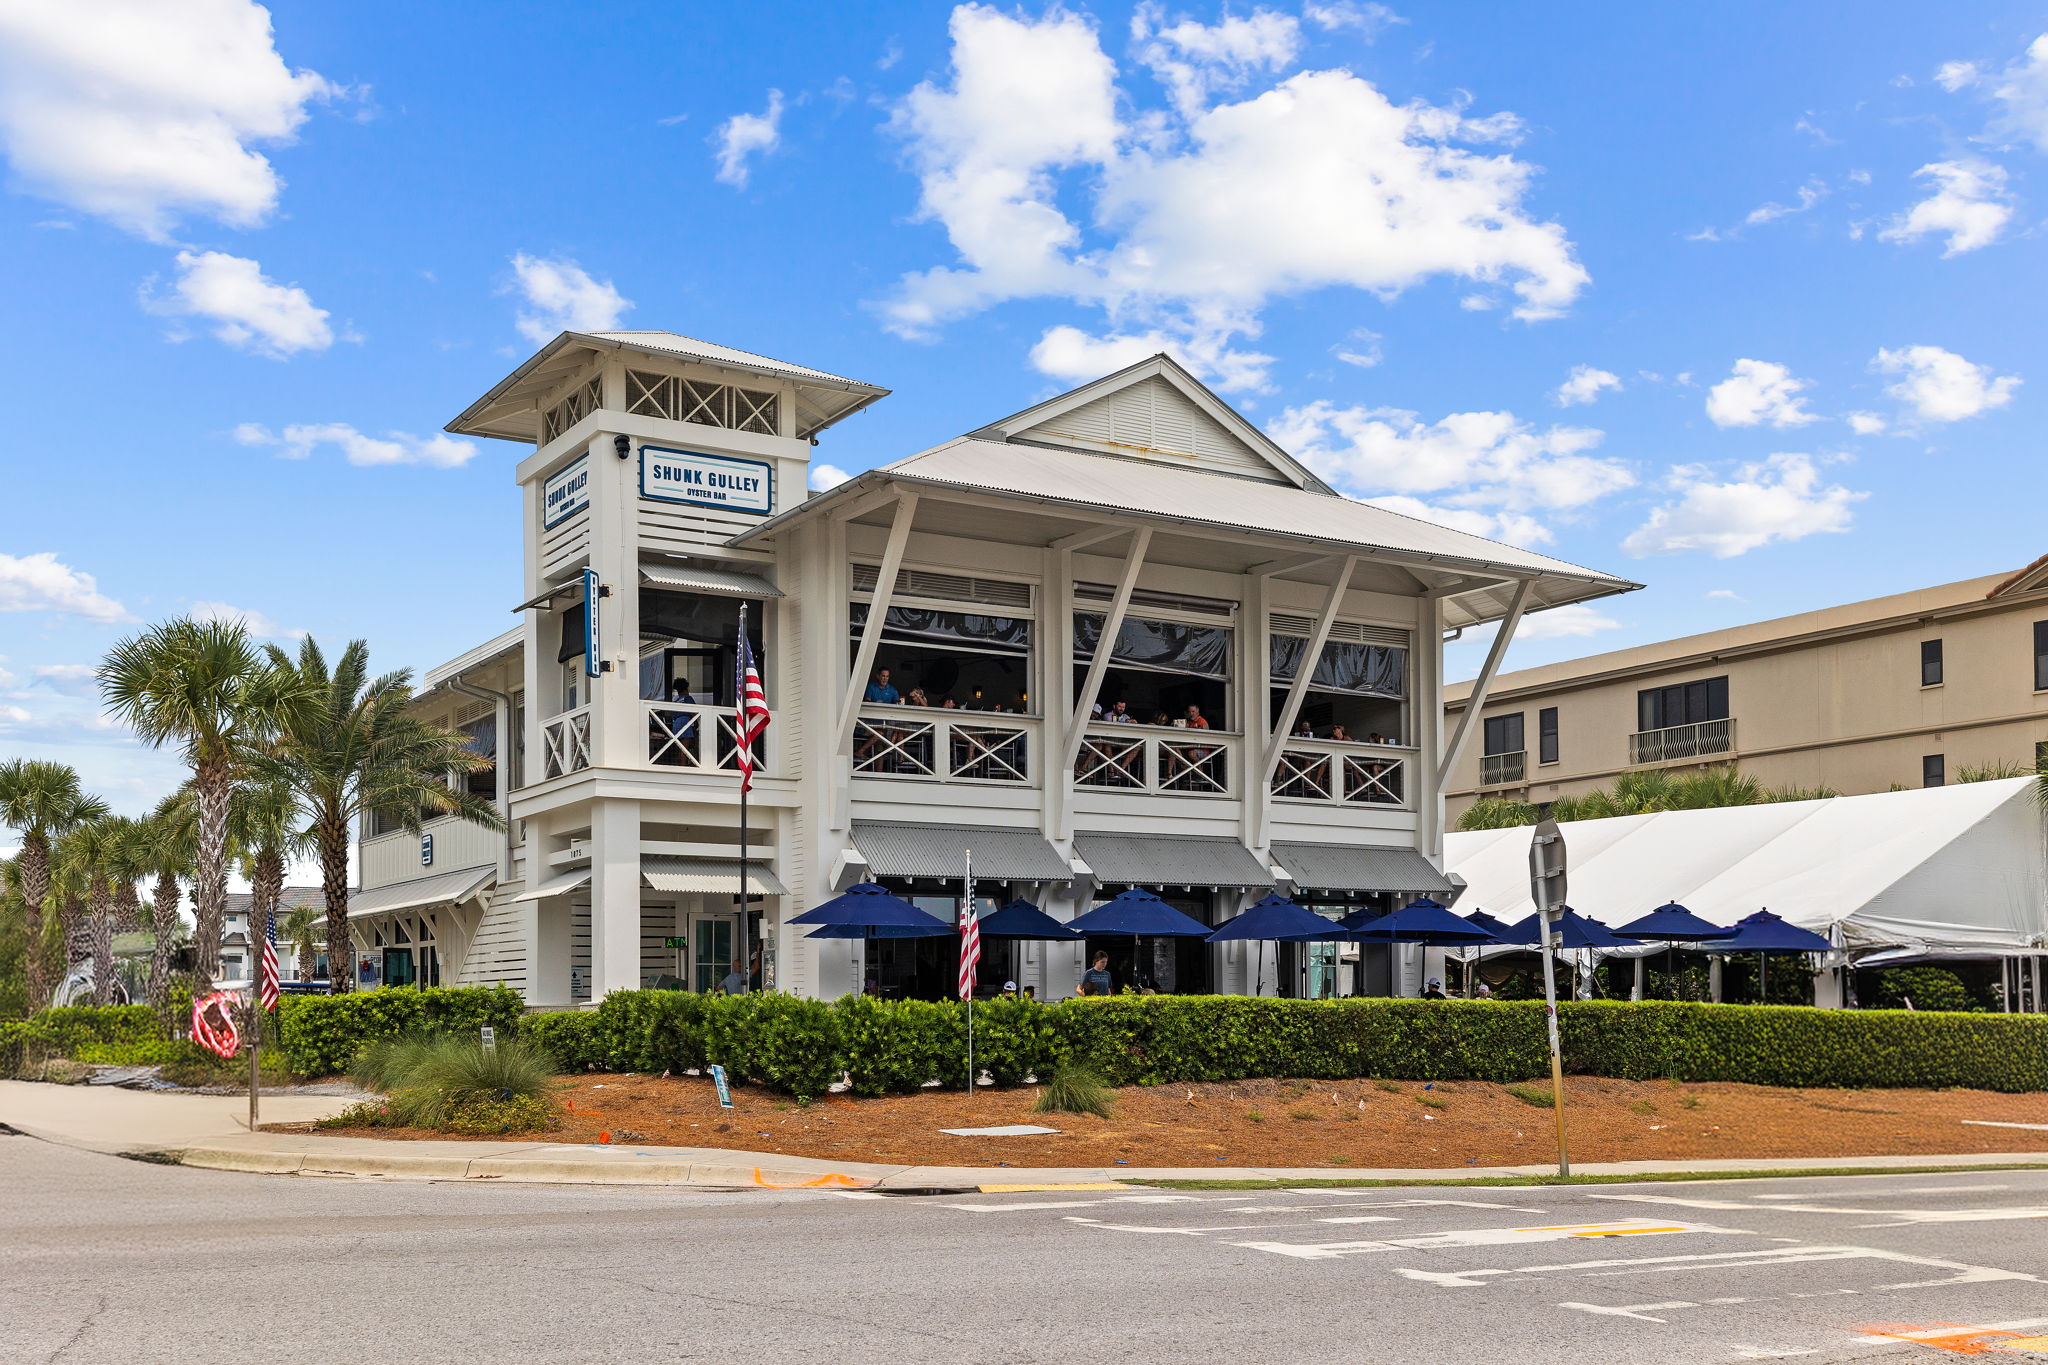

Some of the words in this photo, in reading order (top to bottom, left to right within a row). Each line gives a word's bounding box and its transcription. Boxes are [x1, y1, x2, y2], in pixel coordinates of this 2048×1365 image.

[653, 464, 702, 485] SHUNK
[708, 472, 759, 493] GULLEY
[687, 488, 712, 499] OYSTER
[713, 491, 727, 501] BAR
[666, 936, 687, 948] ATM
